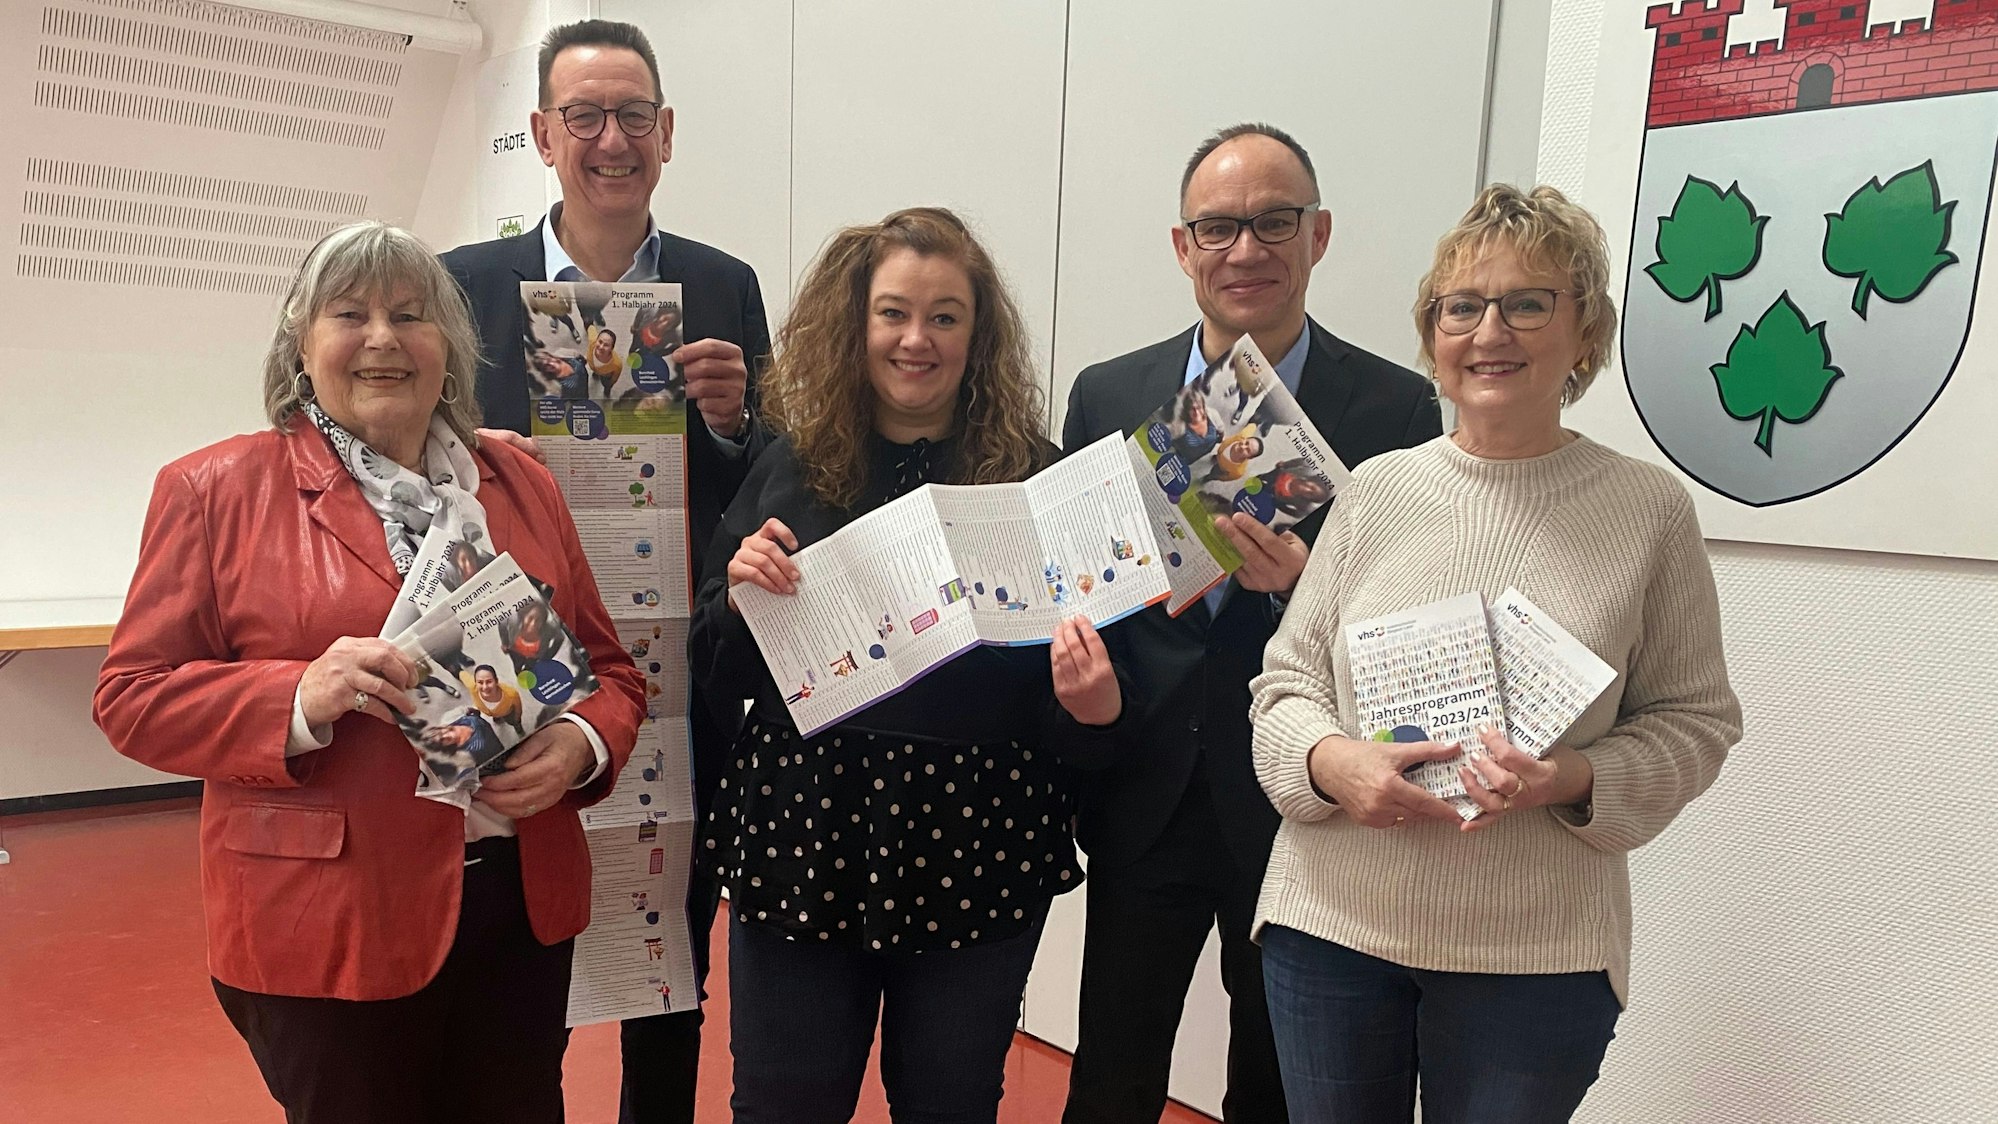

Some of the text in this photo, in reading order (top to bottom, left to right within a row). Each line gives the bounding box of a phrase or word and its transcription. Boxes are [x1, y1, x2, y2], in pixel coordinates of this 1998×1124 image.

[493, 132, 526, 154] STÄDTE
[532, 290, 548, 299] vhs
[611, 290, 654, 300] Programm
[622, 301, 656, 310] Halbjahr
[658, 301, 678, 309] 2024
[1242, 351, 1255, 367] vhs
[1294, 421, 1326, 463] Programm
[1285, 428, 1335, 491] 1. Halbjahr 2024
[408, 559, 435, 604] Programm
[420, 540, 457, 609] 1. Halbjahr 2024
[451, 580, 492, 614] Programm
[460, 600, 505, 630] Programm
[466, 595, 534, 640] 1. Halbjahr 2024
[1507, 603, 1523, 619] vhs
[1357, 630, 1375, 640] vhs
[1370, 688, 1486, 722] Jahresprogramm
[1432, 705, 1489, 728] 2023/24
